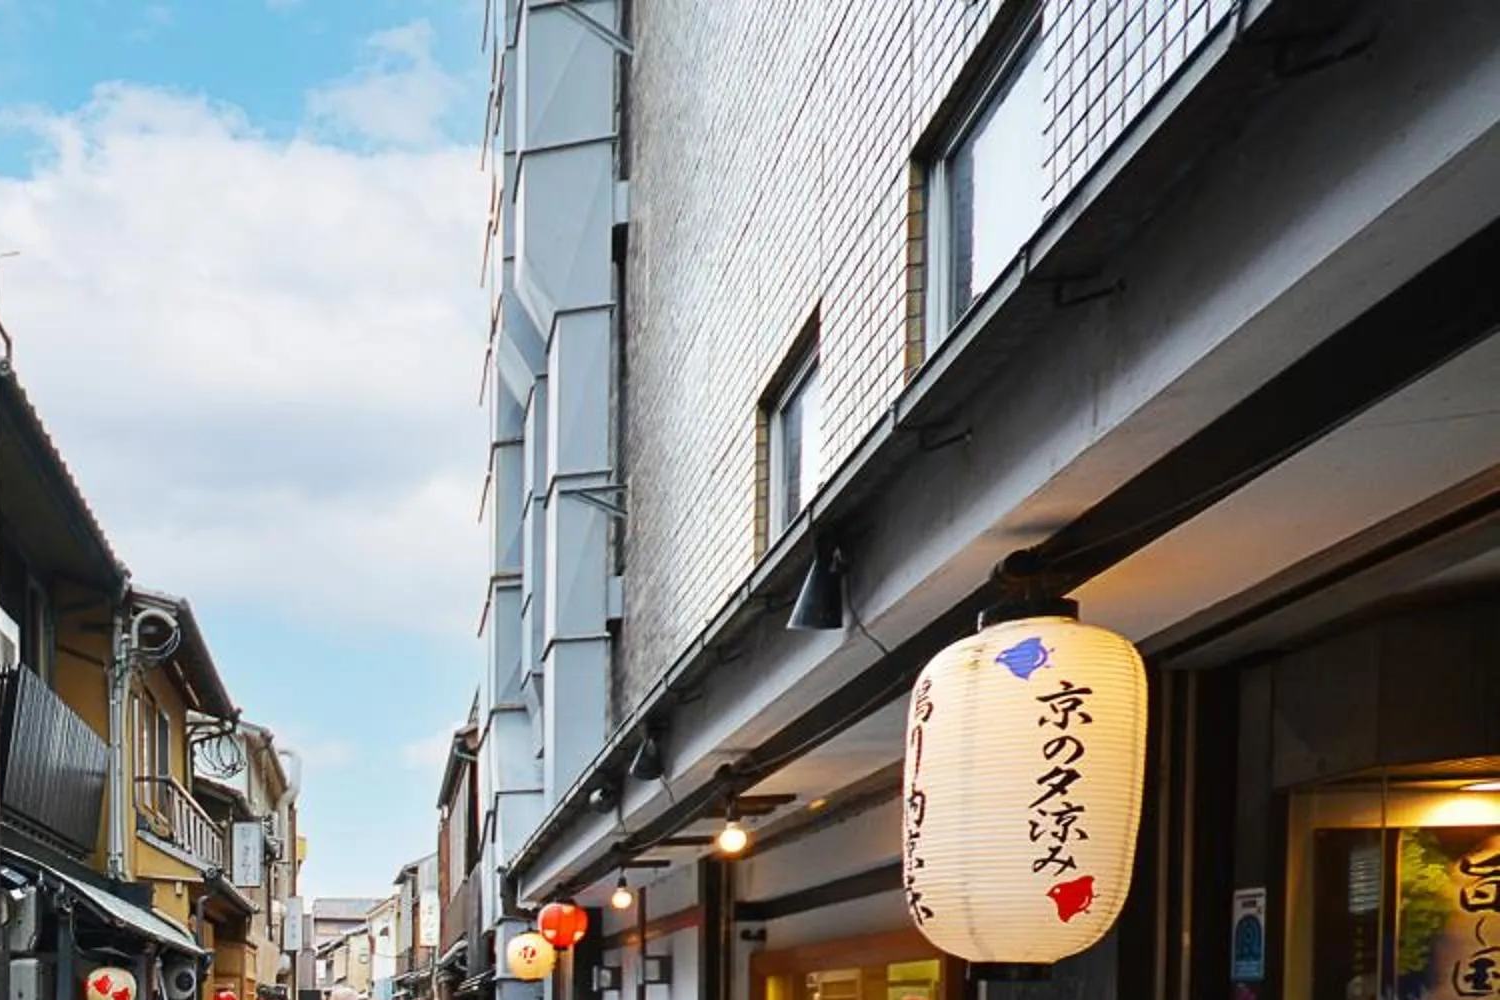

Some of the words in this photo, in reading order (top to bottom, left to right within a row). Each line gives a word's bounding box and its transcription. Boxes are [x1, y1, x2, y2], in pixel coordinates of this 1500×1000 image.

[1028, 680, 1094, 877] 京の夕涼み
